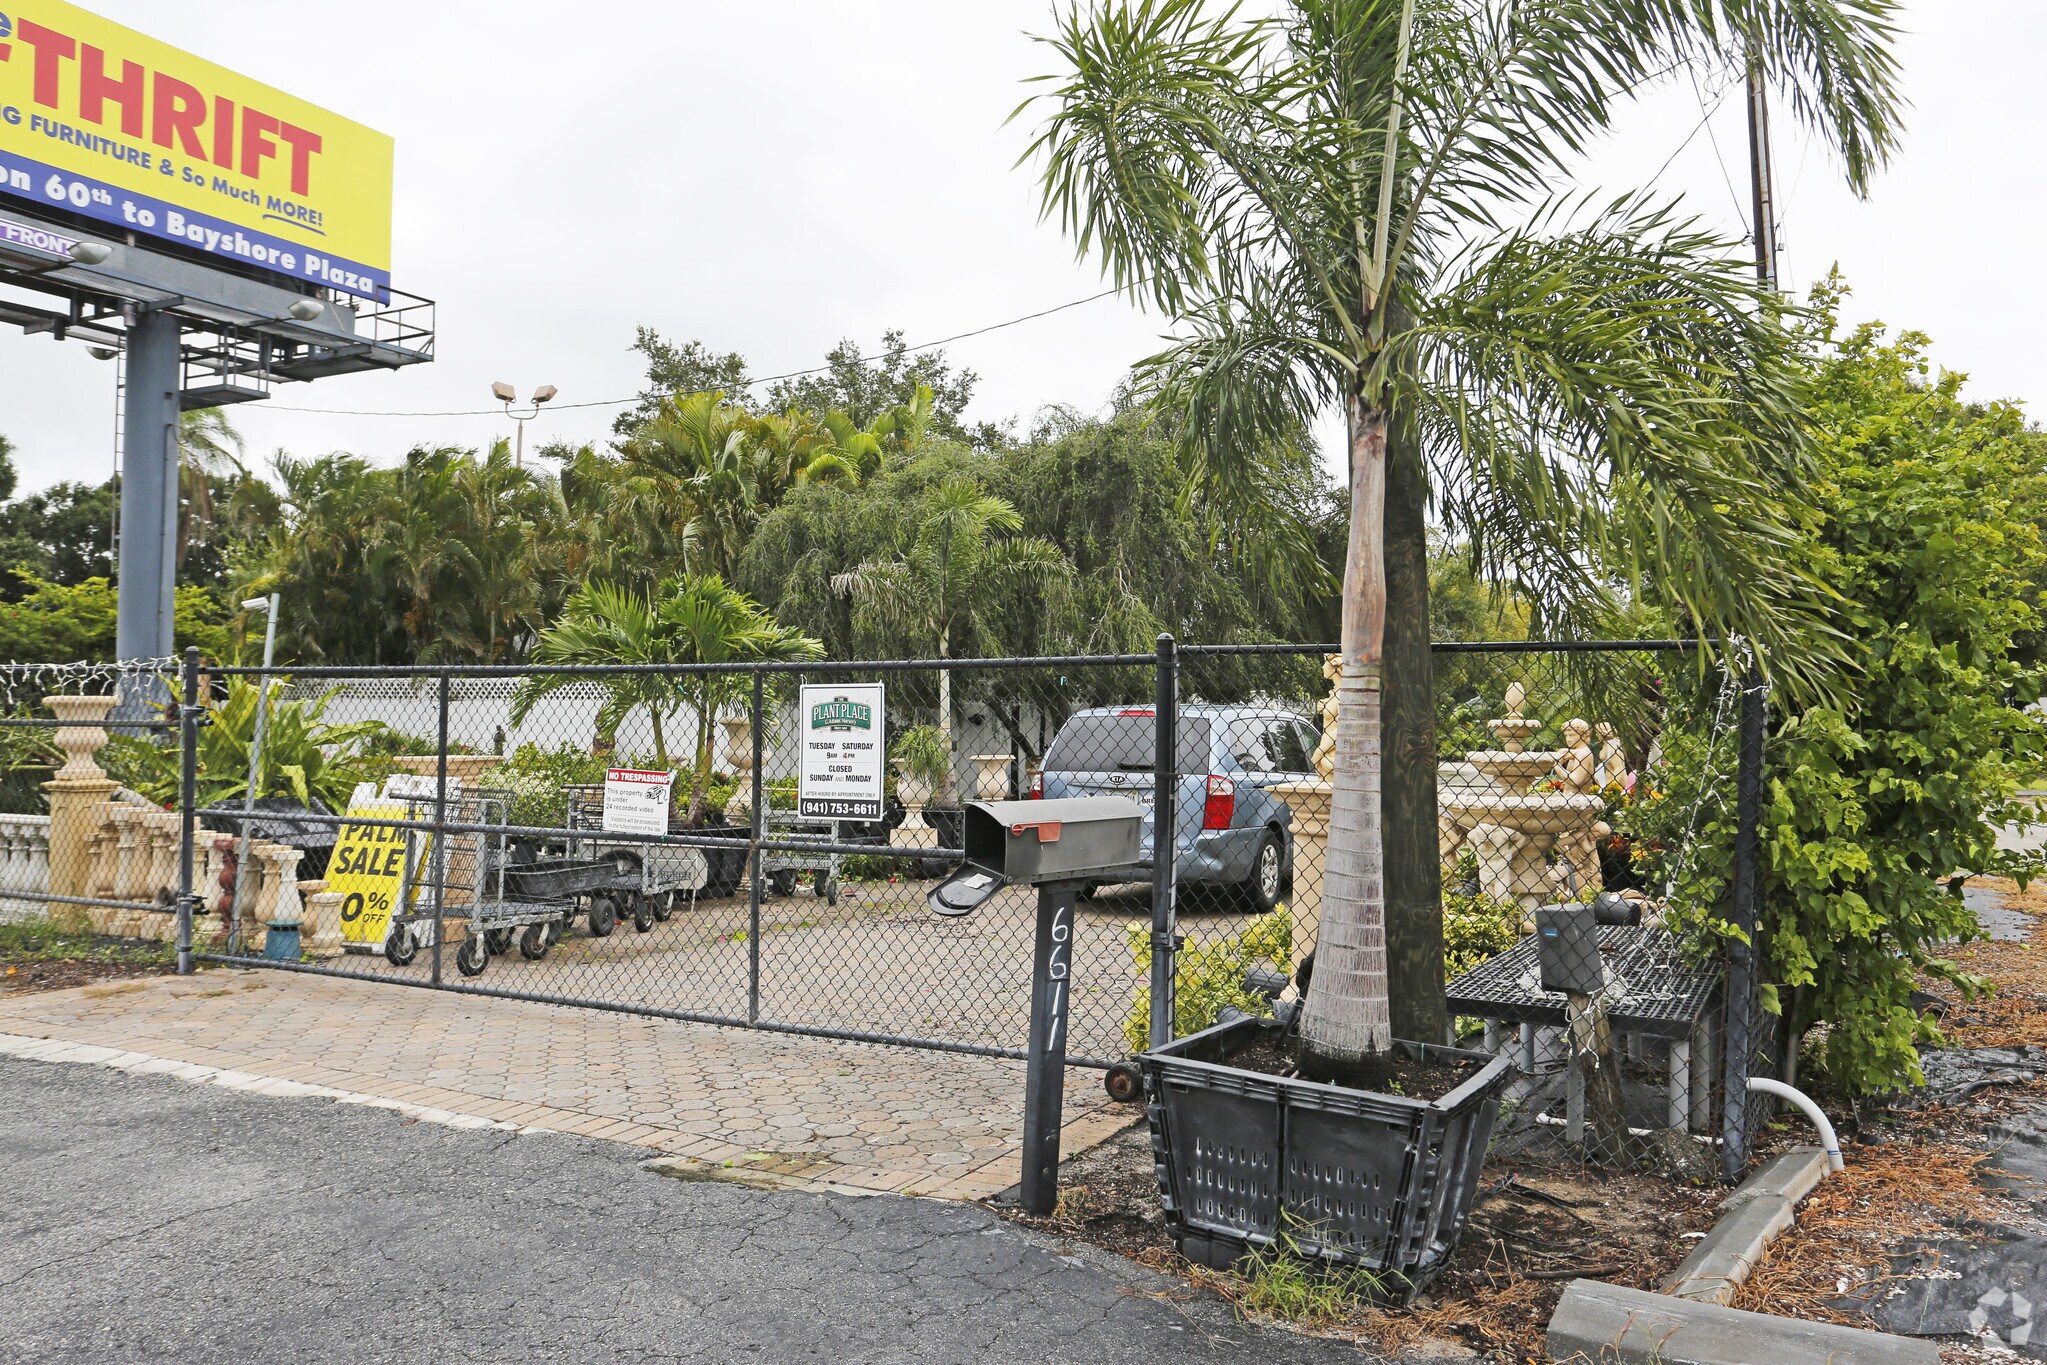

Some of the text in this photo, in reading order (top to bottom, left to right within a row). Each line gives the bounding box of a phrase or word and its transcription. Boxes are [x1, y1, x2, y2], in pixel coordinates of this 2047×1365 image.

[17, 16, 323, 198] THRIFT
[0, 103, 323, 227] G FURNITURE & So Much MORE!
[45, 174, 113, 208] 60th
[122, 200, 156, 228] to
[166, 210, 297, 270] Bayshore
[304, 253, 374, 294] Plaza
[813, 703, 869, 721] PLANT PLACE
[809, 742, 874, 750] TUESDAY SATURDAY
[828, 765, 853, 773] CLOSED
[609, 772, 668, 783] NO TRESPASSING
[809, 774, 834, 782] SUNDAY
[845, 774, 872, 783] MONDAY
[620, 789, 643, 798] property
[614, 804, 638, 812] recorded
[802, 801, 877, 815] (941) 753-6611
[344, 823, 407, 844] PALM
[334, 846, 406, 877] SALE
[362, 913, 386, 924] OFF
[1048, 907, 1068, 1052] 6611
